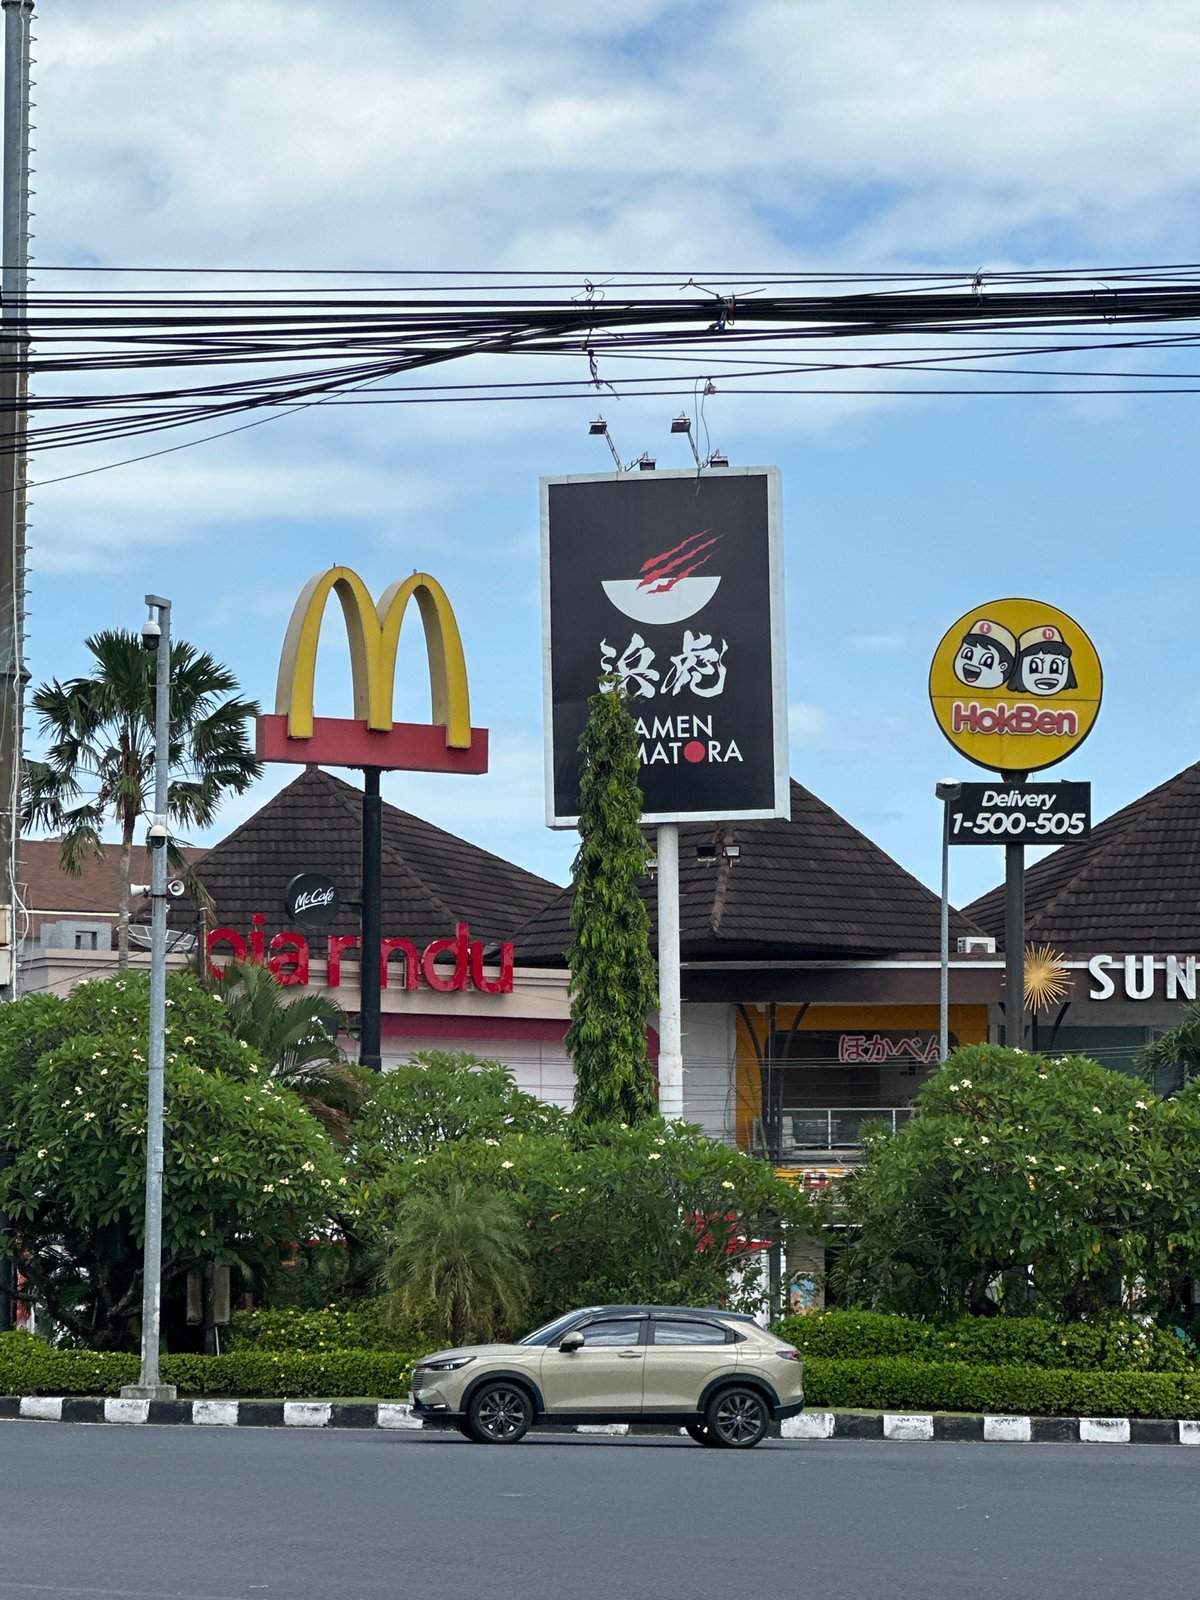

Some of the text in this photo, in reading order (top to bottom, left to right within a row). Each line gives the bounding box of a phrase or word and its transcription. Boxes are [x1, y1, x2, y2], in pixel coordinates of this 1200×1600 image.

[635, 714, 713, 739] AMEN
[952, 701, 1078, 735] HokBen
[981, 790, 1057, 811] Delivery
[952, 812, 1087, 835] 1-500-505
[1088, 954, 1197, 1000] SUN
